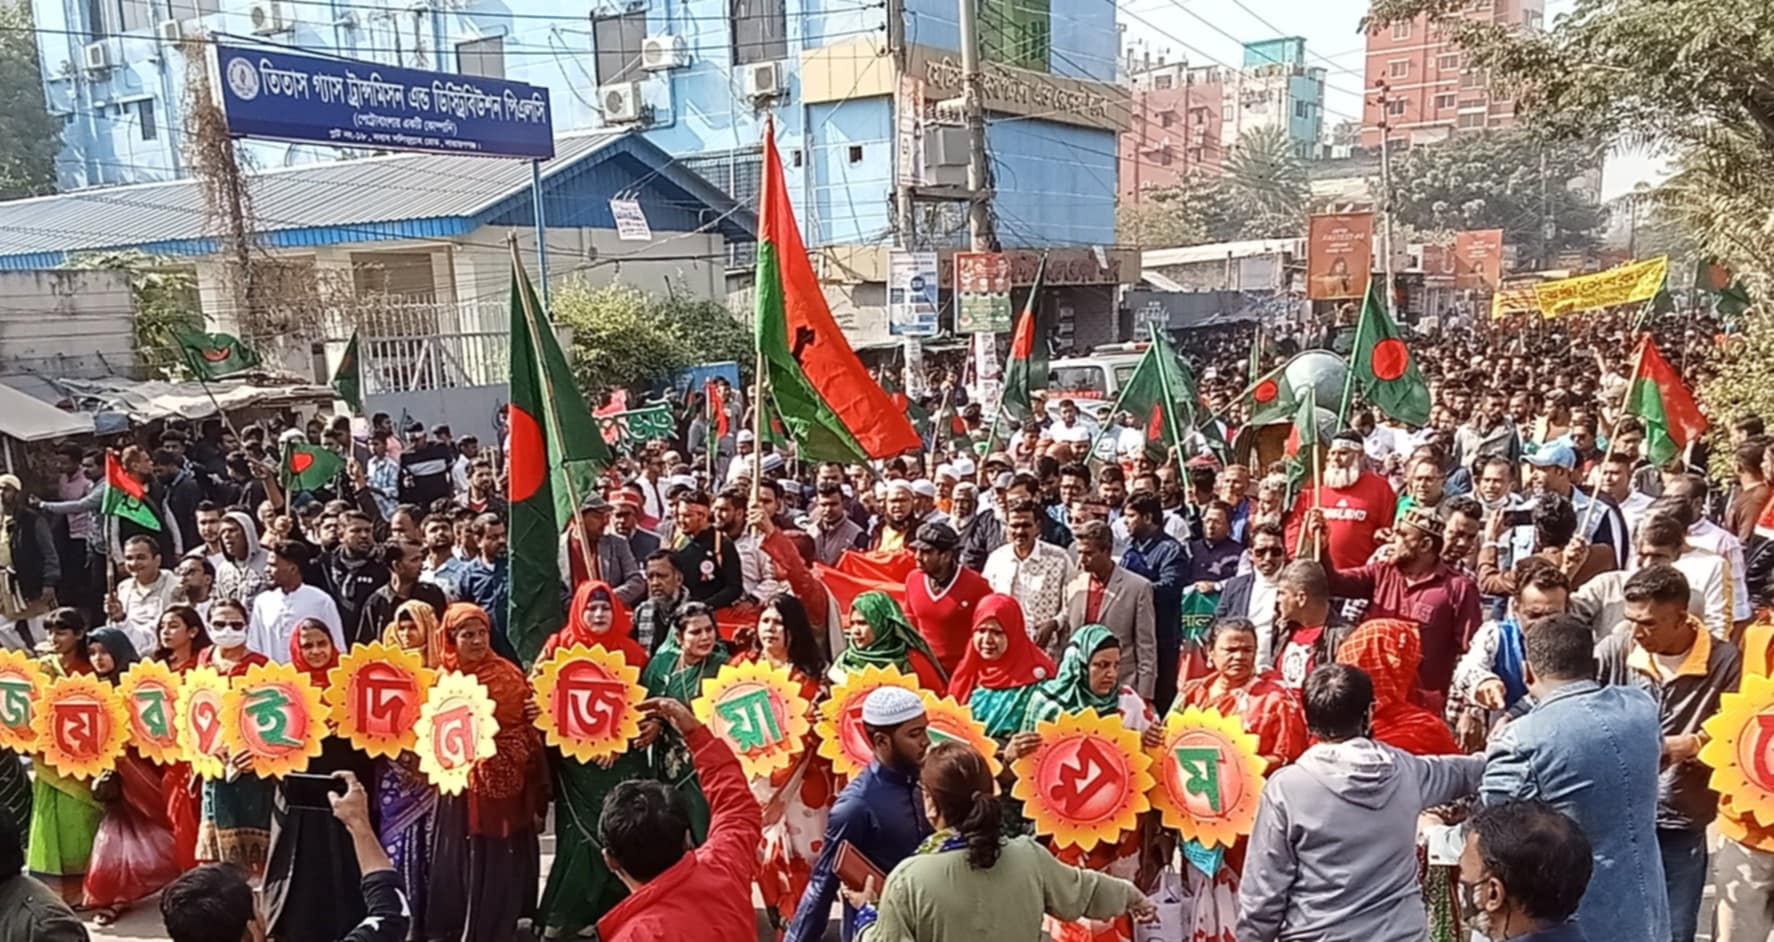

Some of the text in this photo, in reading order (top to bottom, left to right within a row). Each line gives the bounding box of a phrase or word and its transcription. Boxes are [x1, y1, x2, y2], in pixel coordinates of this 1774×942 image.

[260, 58, 309, 99] তিতাস
[313, 72, 345, 103] গ্যাস
[409, 86, 430, 111] এন্ড
[504, 89, 546, 123] পিএলসি
[0, 682, 31, 727] জ
[245, 688, 304, 745] ই
[355, 661, 413, 733] দি
[557, 660, 625, 737] জি
[715, 689, 783, 751] য়া
[431, 705, 475, 769] নে
